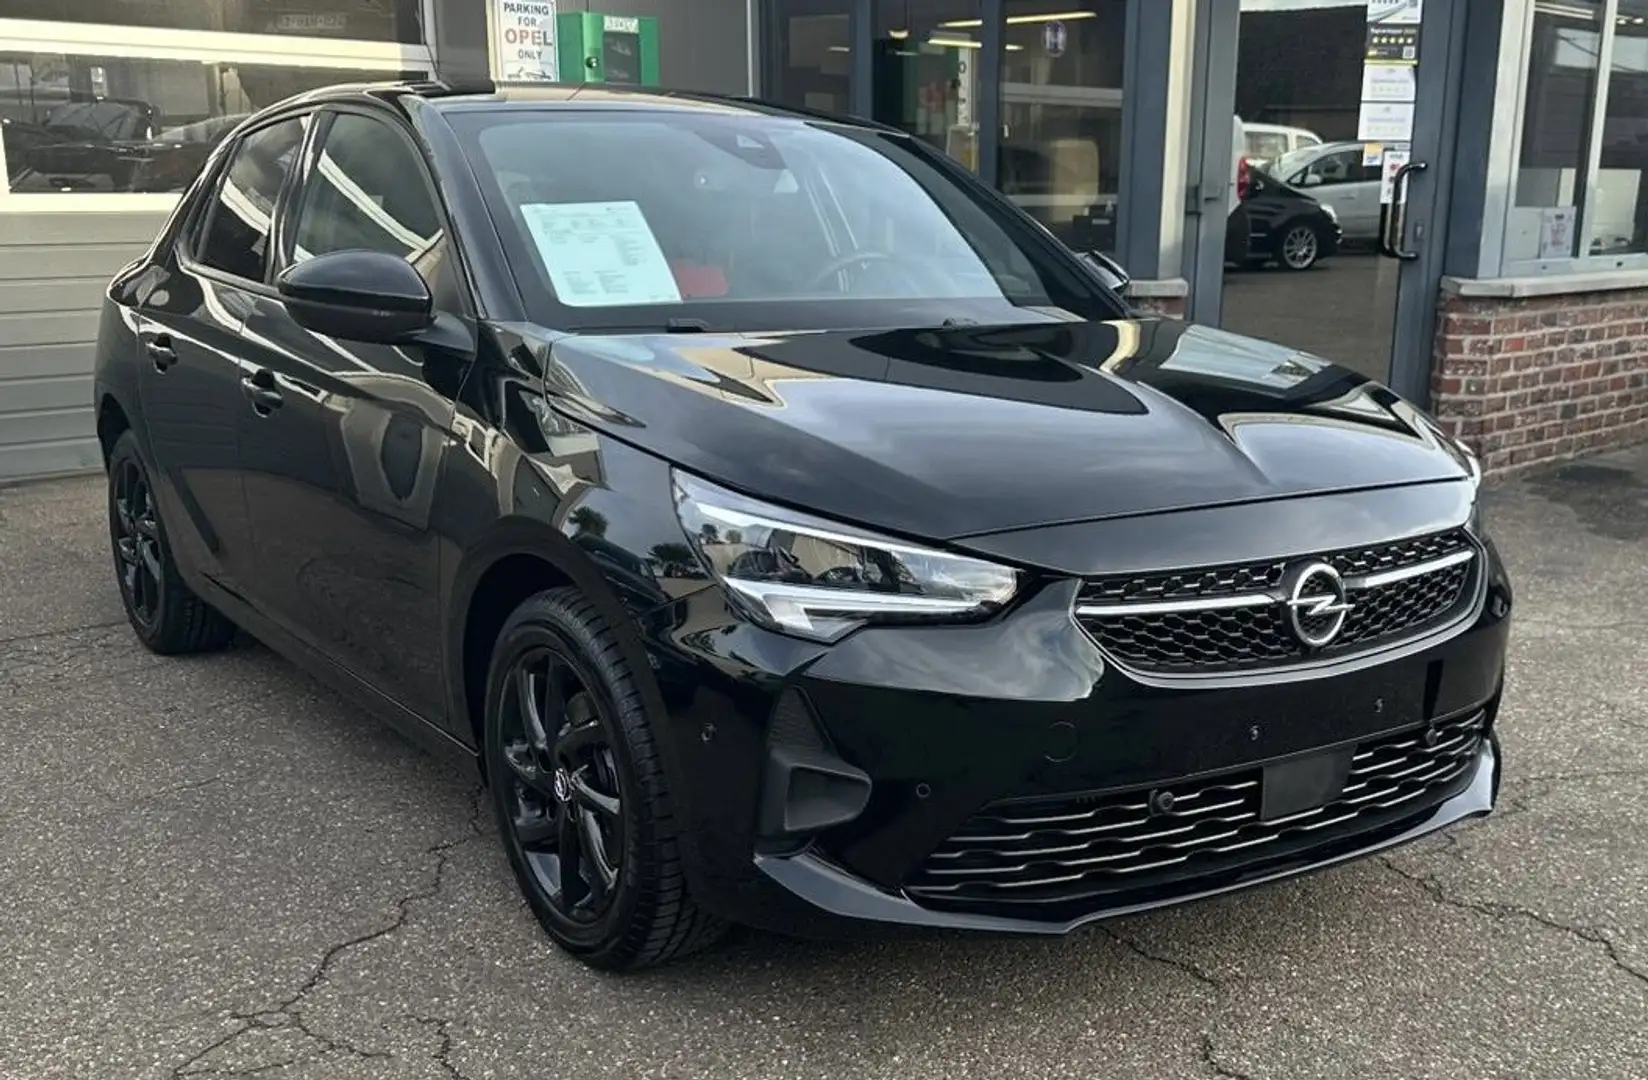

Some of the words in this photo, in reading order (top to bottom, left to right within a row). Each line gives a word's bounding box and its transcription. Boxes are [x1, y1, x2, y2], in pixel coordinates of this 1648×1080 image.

[503, 2, 549, 16] PARKING
[518, 16, 537, 27] FOR
[505, 28, 553, 46] OPEL
[518, 49, 543, 60] ONLY
